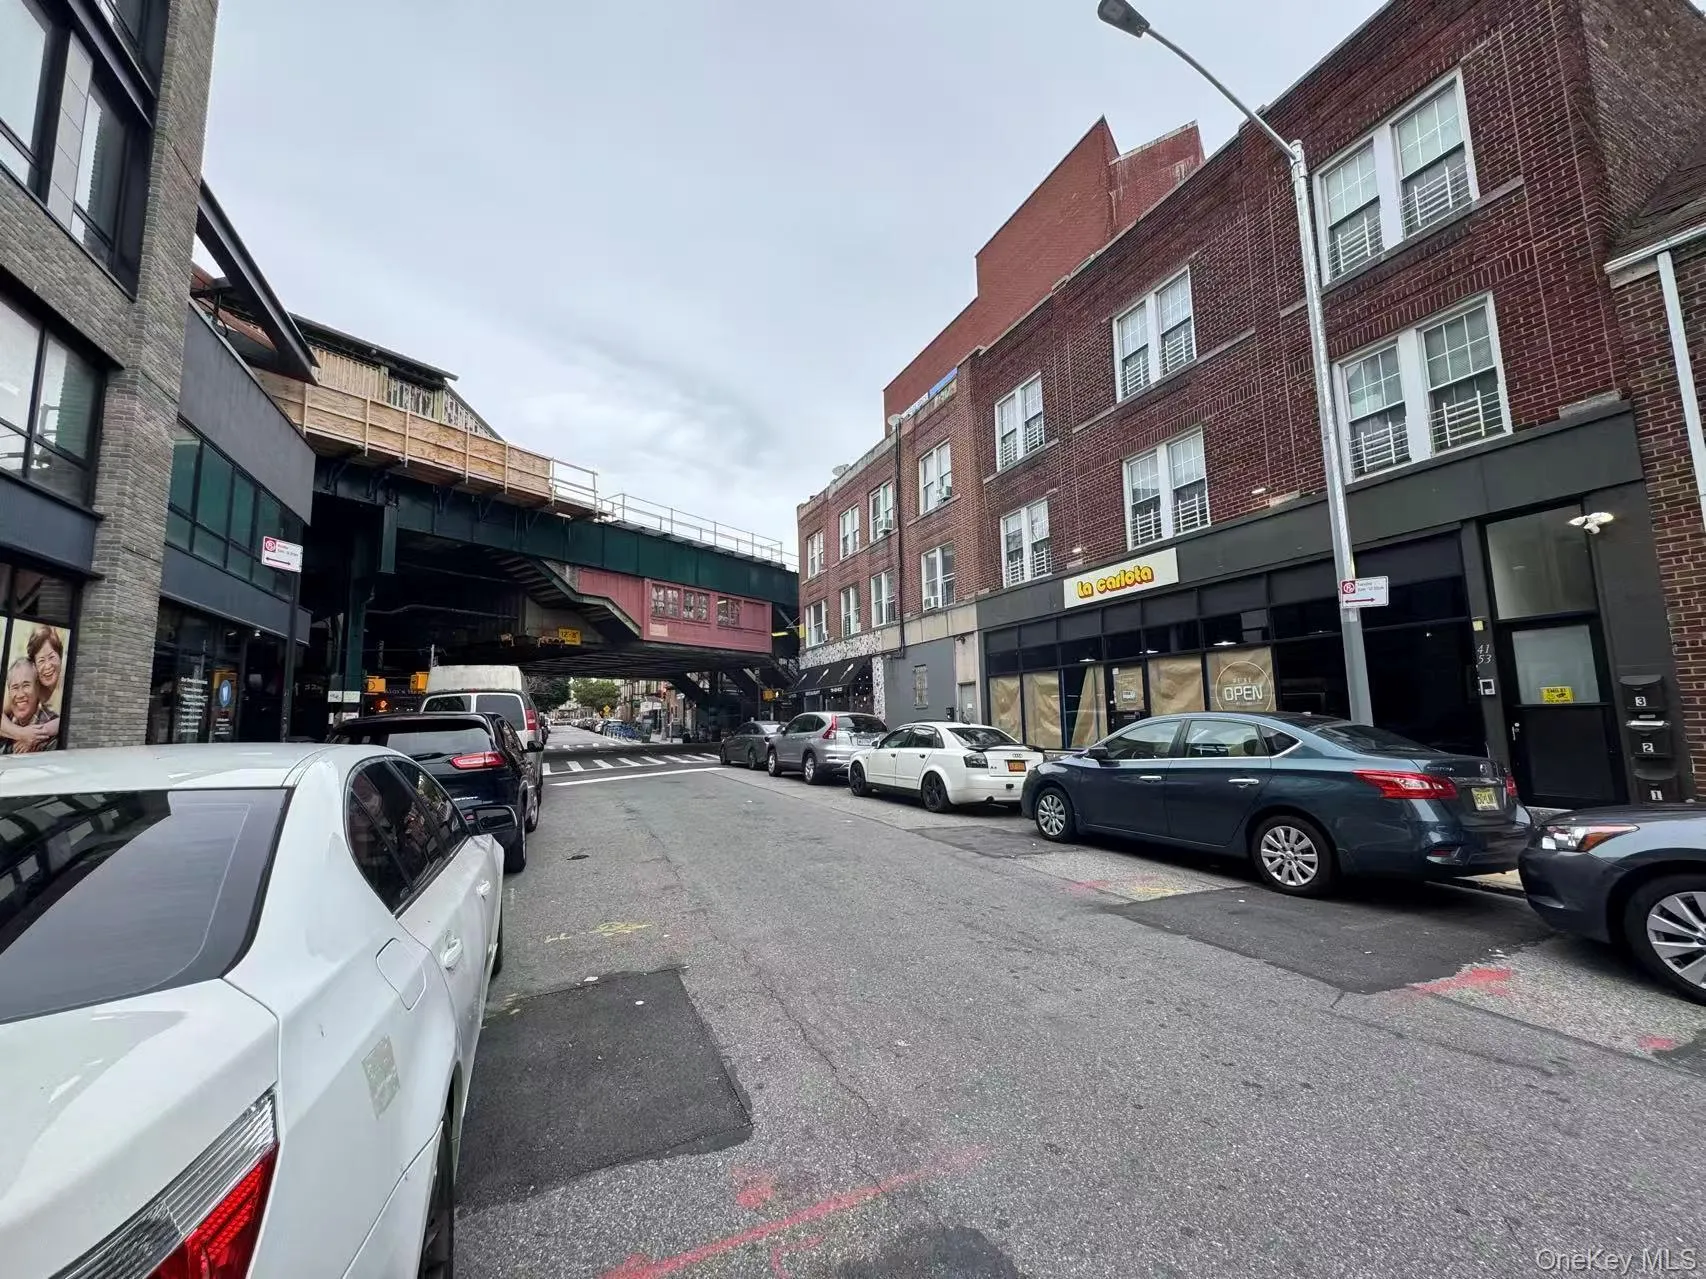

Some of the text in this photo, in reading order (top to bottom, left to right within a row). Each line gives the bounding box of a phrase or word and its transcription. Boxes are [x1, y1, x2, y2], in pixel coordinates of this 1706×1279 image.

[1077, 566, 1154, 597] la carlota
[1477, 644, 1490, 654] 41
[1478, 655, 1491, 664] 53
[1224, 685, 1263, 701] OPEN
